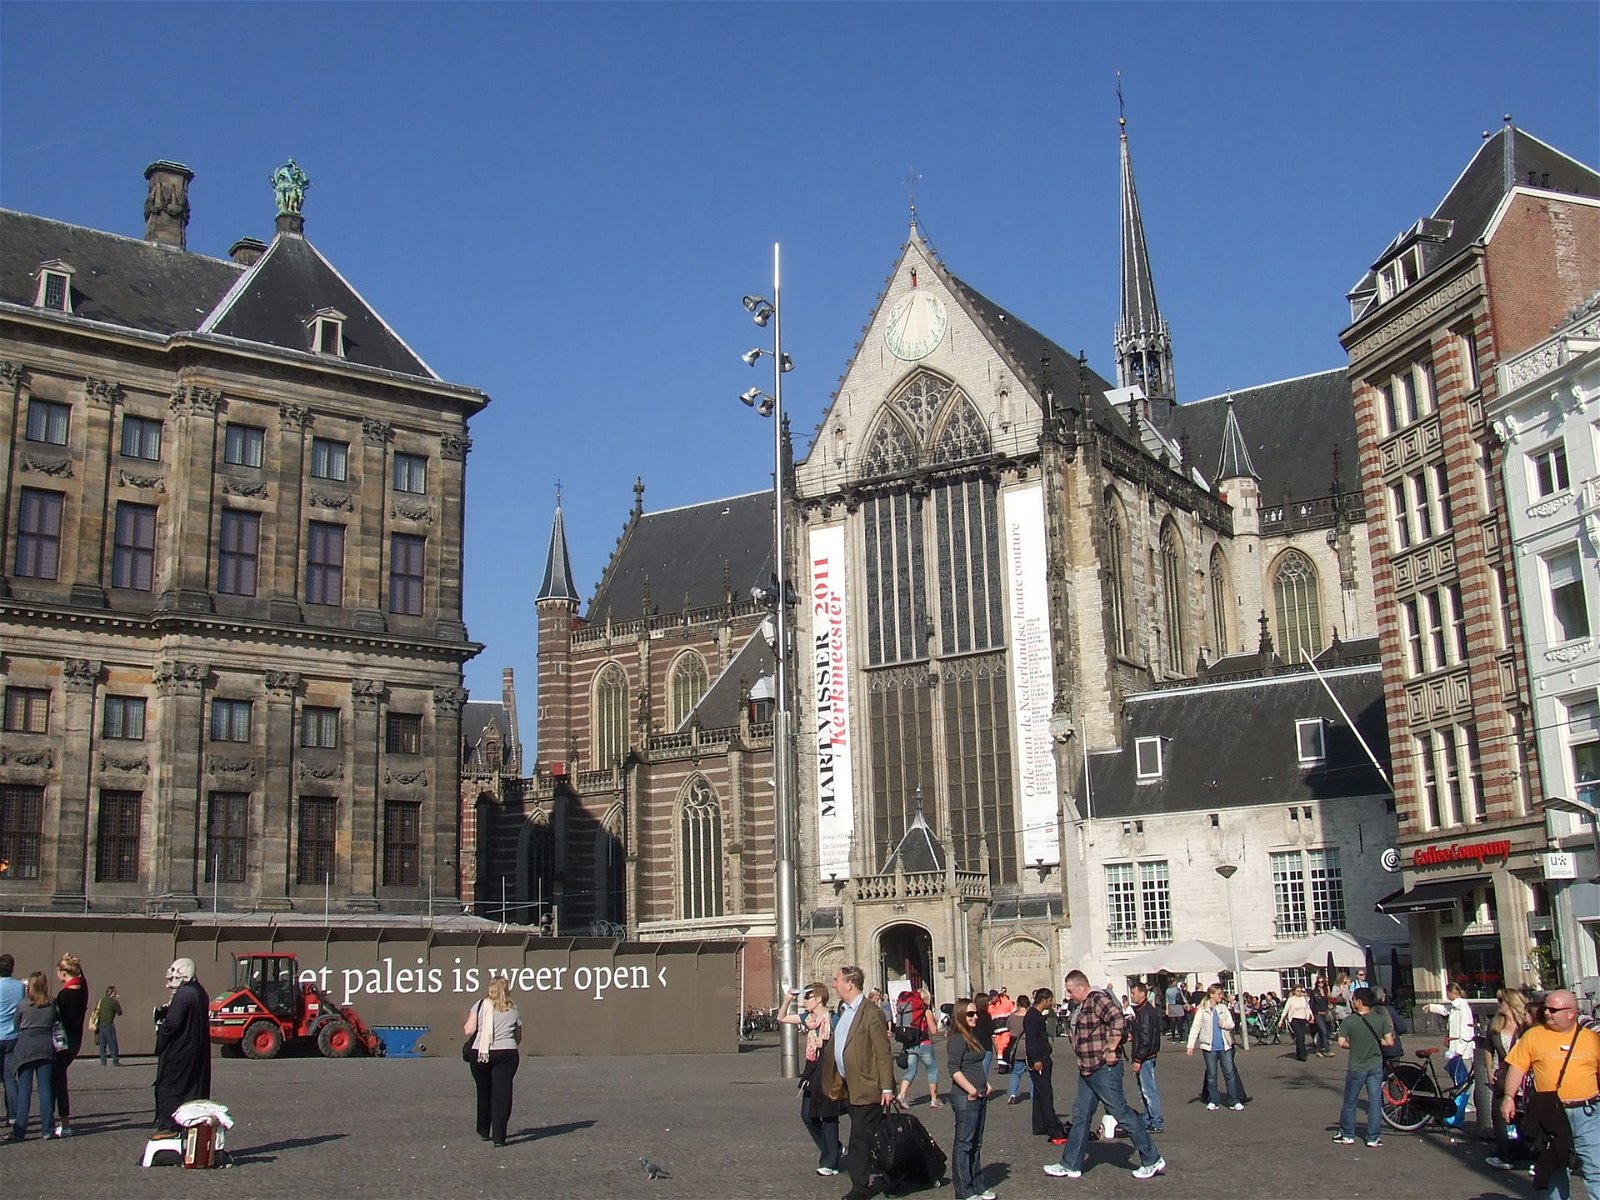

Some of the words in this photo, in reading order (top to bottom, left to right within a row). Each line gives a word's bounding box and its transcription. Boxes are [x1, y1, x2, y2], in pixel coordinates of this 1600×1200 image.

[1012, 523, 1023, 576] couture
[813, 556, 830, 617] 2011
[1013, 580, 1025, 618] haute
[815, 631, 833, 735] VISSER
[829, 591, 847, 747] Kerkmeester
[1015, 622, 1030, 711] Nederlandse
[1020, 715, 1031, 732] de
[1024, 737, 1034, 764] aan
[1023, 768, 1036, 797] Ode
[341, 957, 442, 1006] paleis
[452, 957, 480, 993] is
[488, 966, 567, 991] weer
[574, 965, 650, 1000] open
